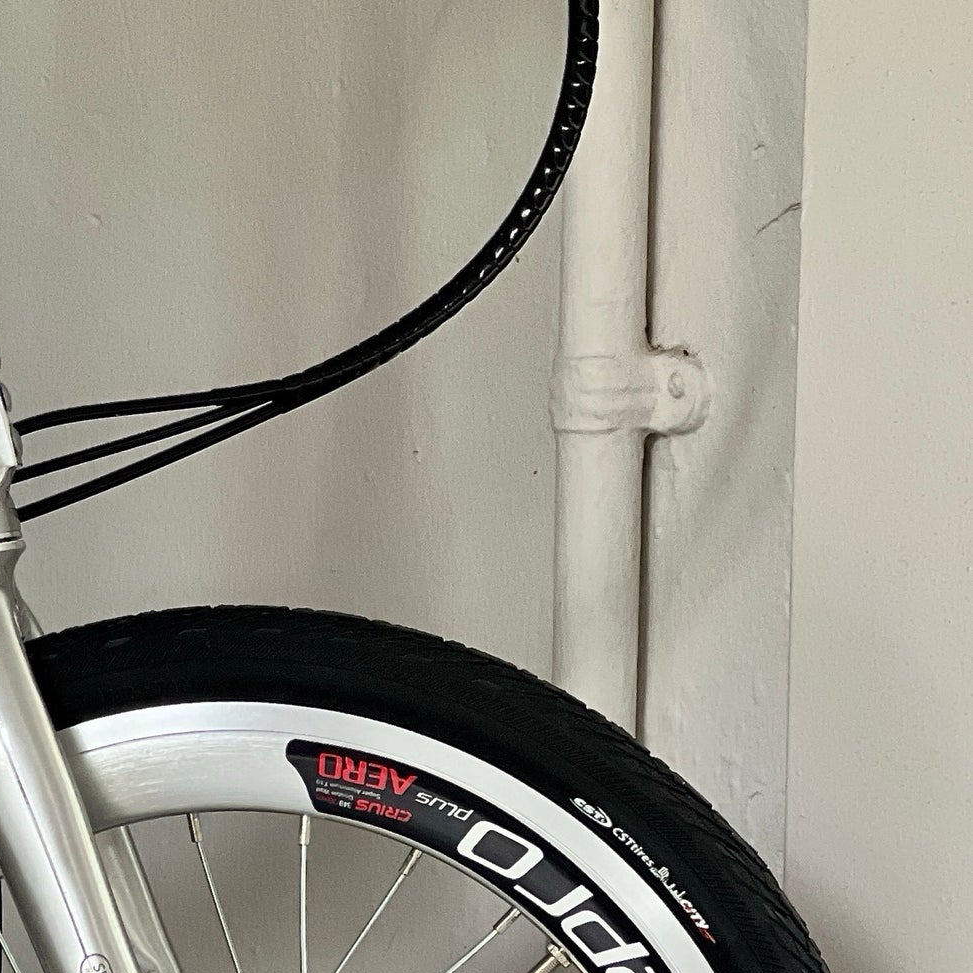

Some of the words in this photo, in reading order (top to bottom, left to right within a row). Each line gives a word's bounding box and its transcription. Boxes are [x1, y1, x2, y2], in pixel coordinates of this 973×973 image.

[318, 753, 418, 796] AERO
[355, 798, 412, 822] CRIUS
[611, 826, 656, 868] CSTtires
